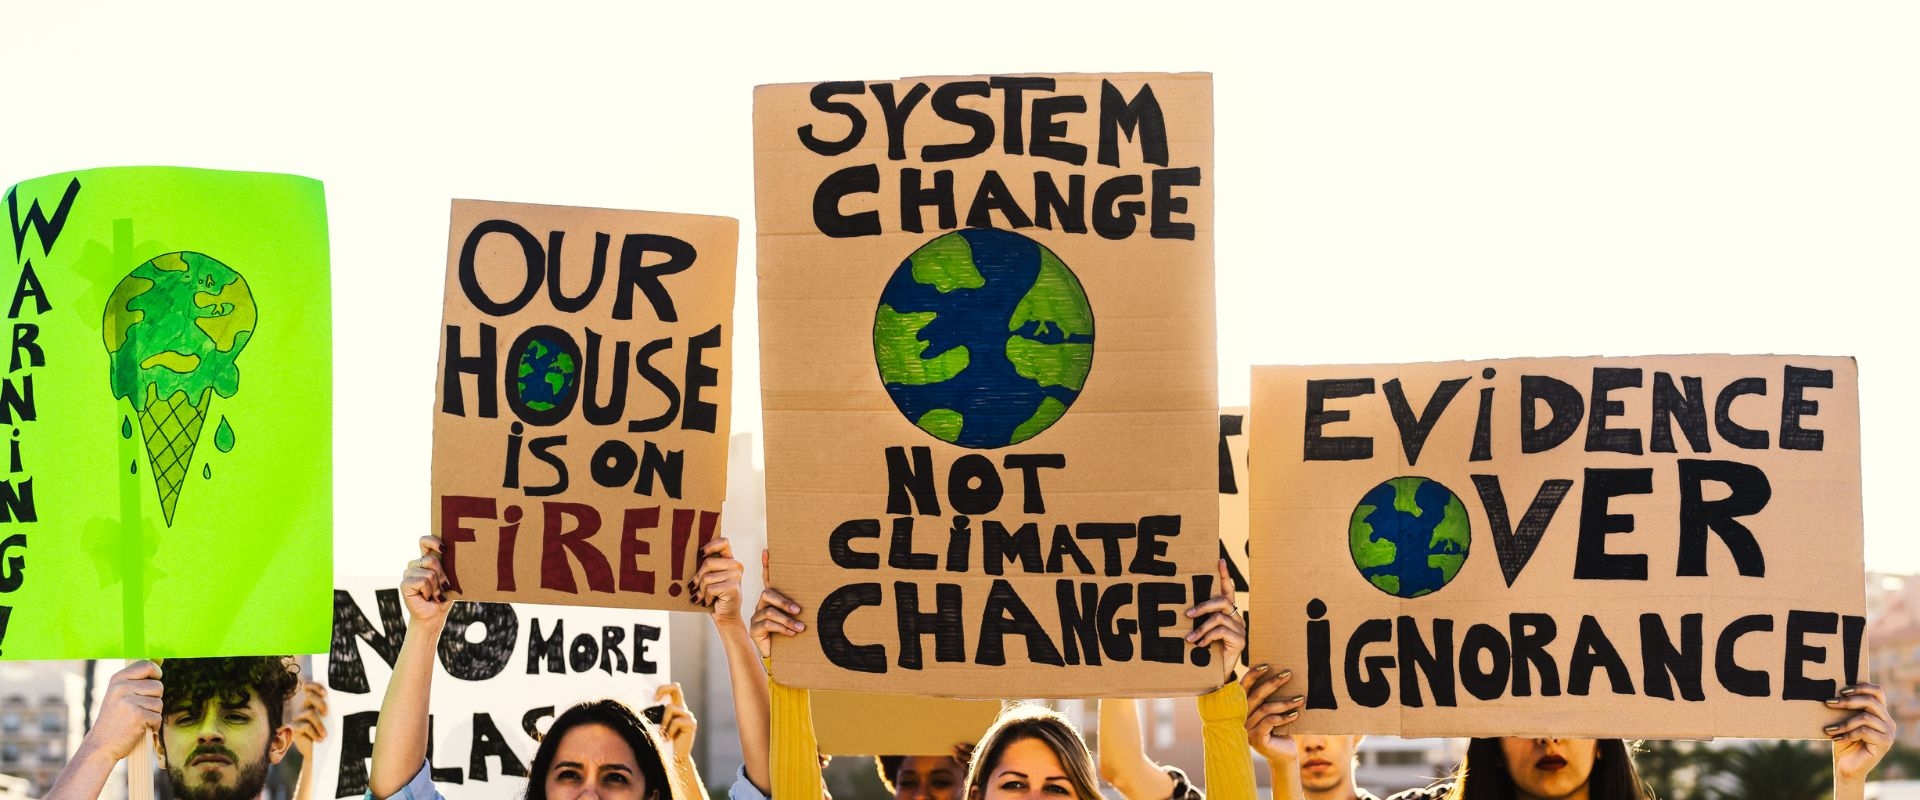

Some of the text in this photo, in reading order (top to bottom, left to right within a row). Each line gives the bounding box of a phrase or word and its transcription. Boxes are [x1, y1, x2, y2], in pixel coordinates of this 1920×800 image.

[797, 76, 1169, 168] SYSTEM
[812, 163, 1202, 241] CHANGE
[458, 219, 697, 322] OUR
[442, 322, 722, 433] HOUSE
[590, 440, 685, 500] ON
[884, 446, 1066, 516] NOT
[328, 588, 661, 694] NO MORE
[816, 575, 1213, 674] CHANGE!
